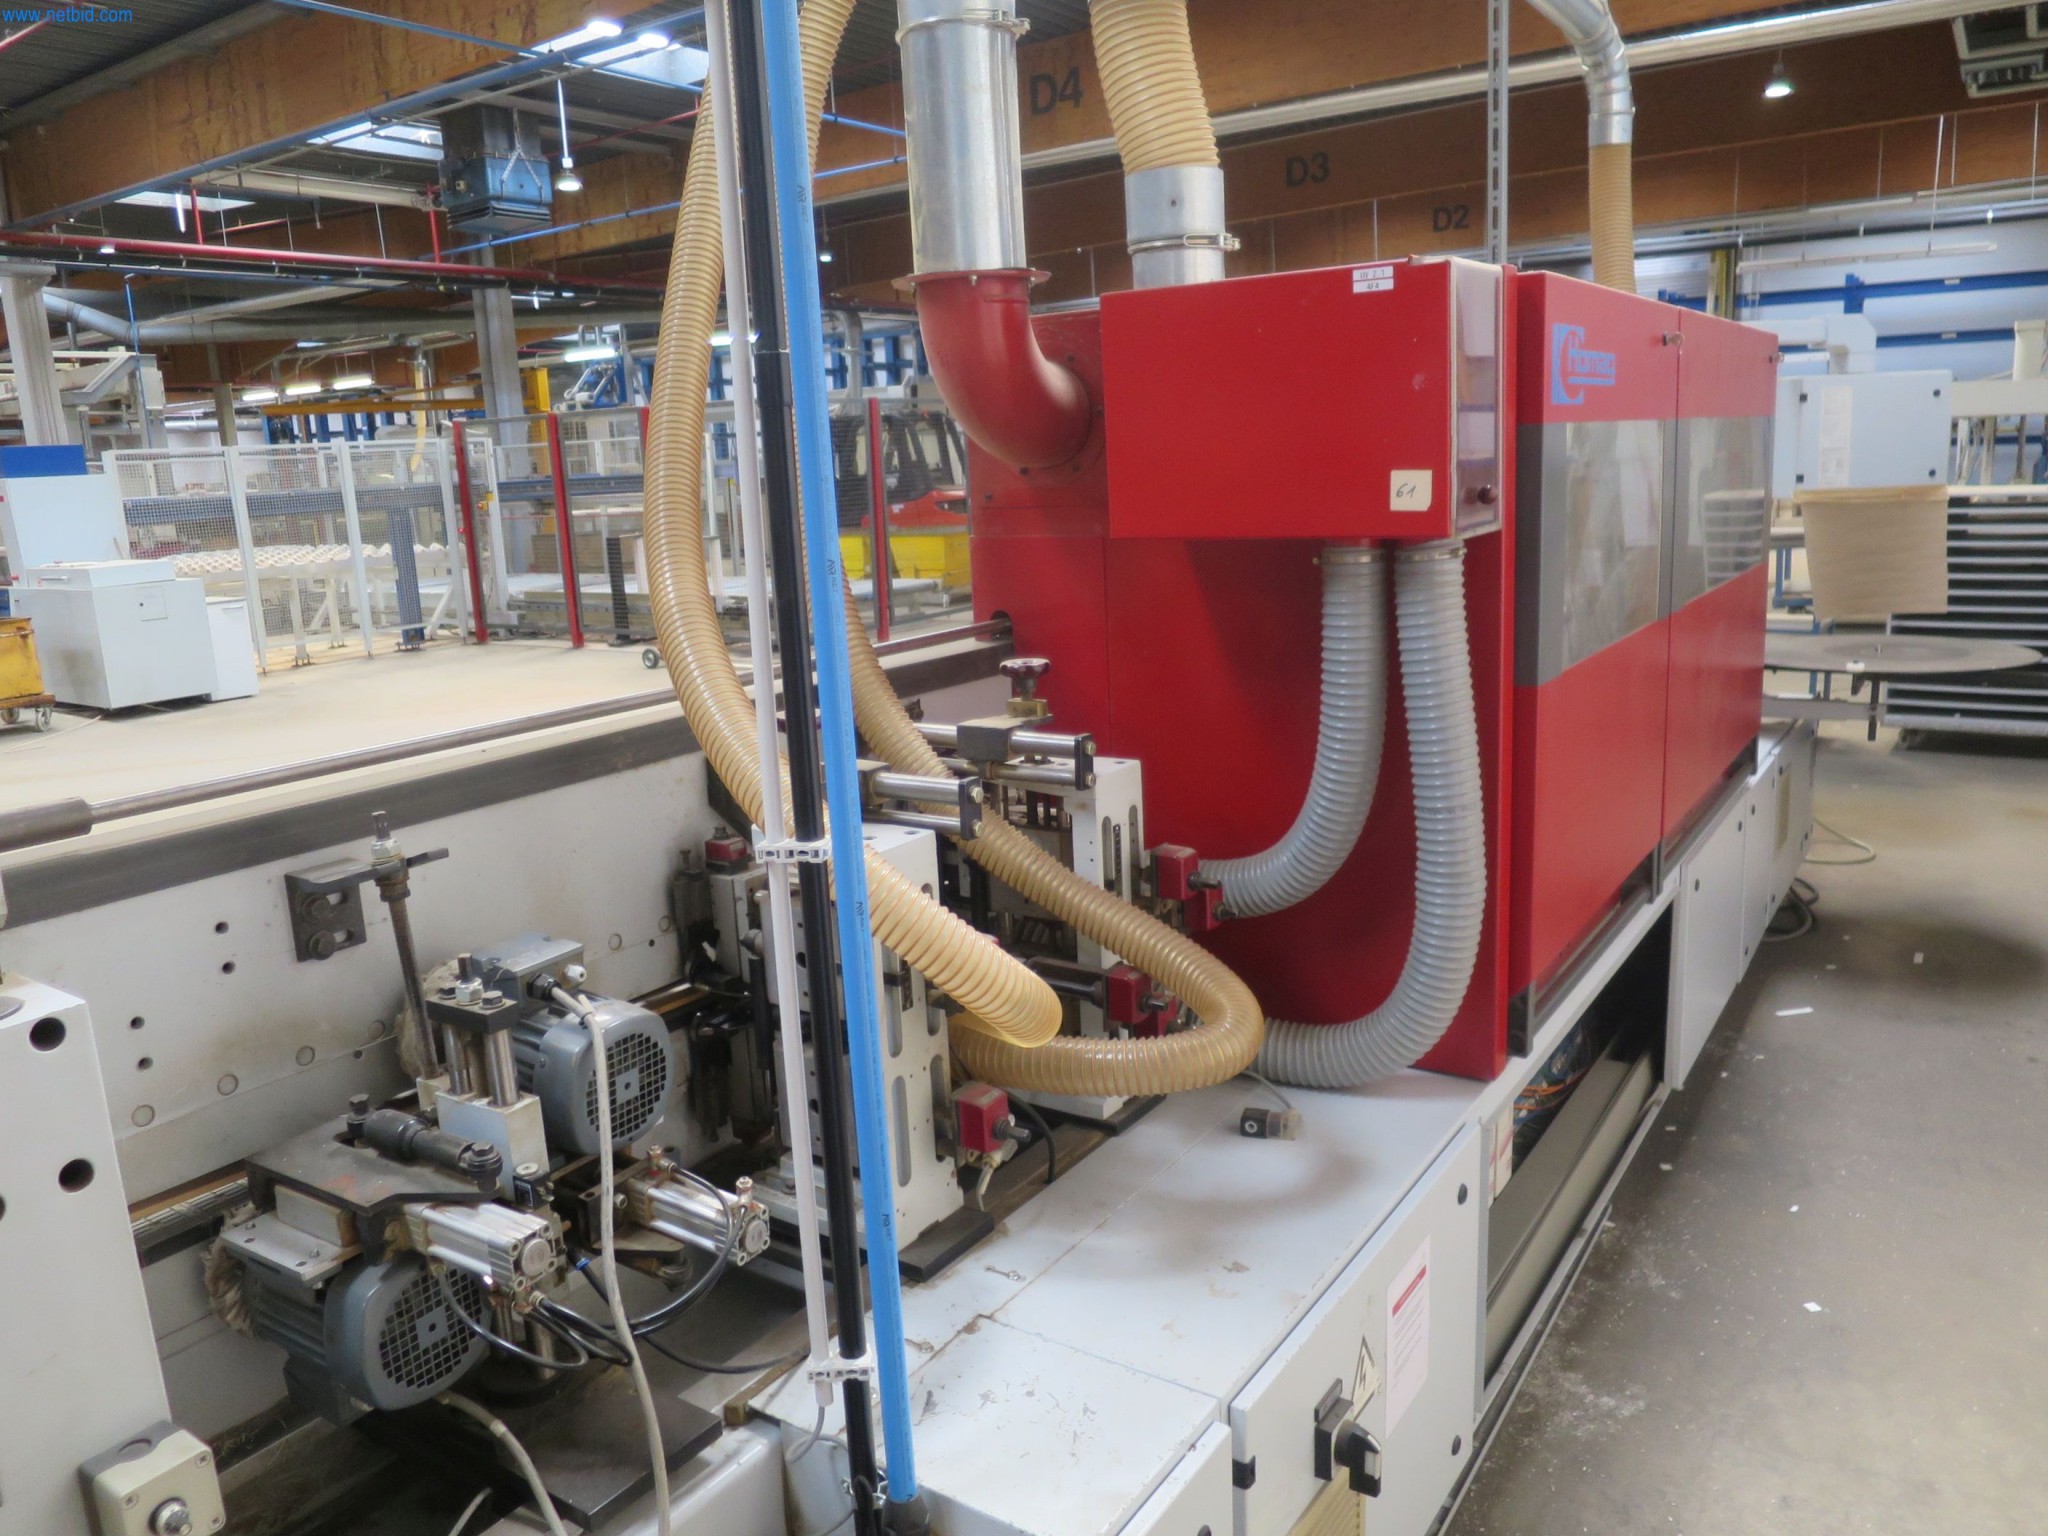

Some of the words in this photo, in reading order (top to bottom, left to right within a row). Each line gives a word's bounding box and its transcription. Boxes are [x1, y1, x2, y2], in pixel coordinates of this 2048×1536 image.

[1029, 66, 1083, 115] D4
[1286, 152, 1330, 187] D3
[1433, 204, 1470, 232] D2
[1396, 482, 1417, 498] 61
